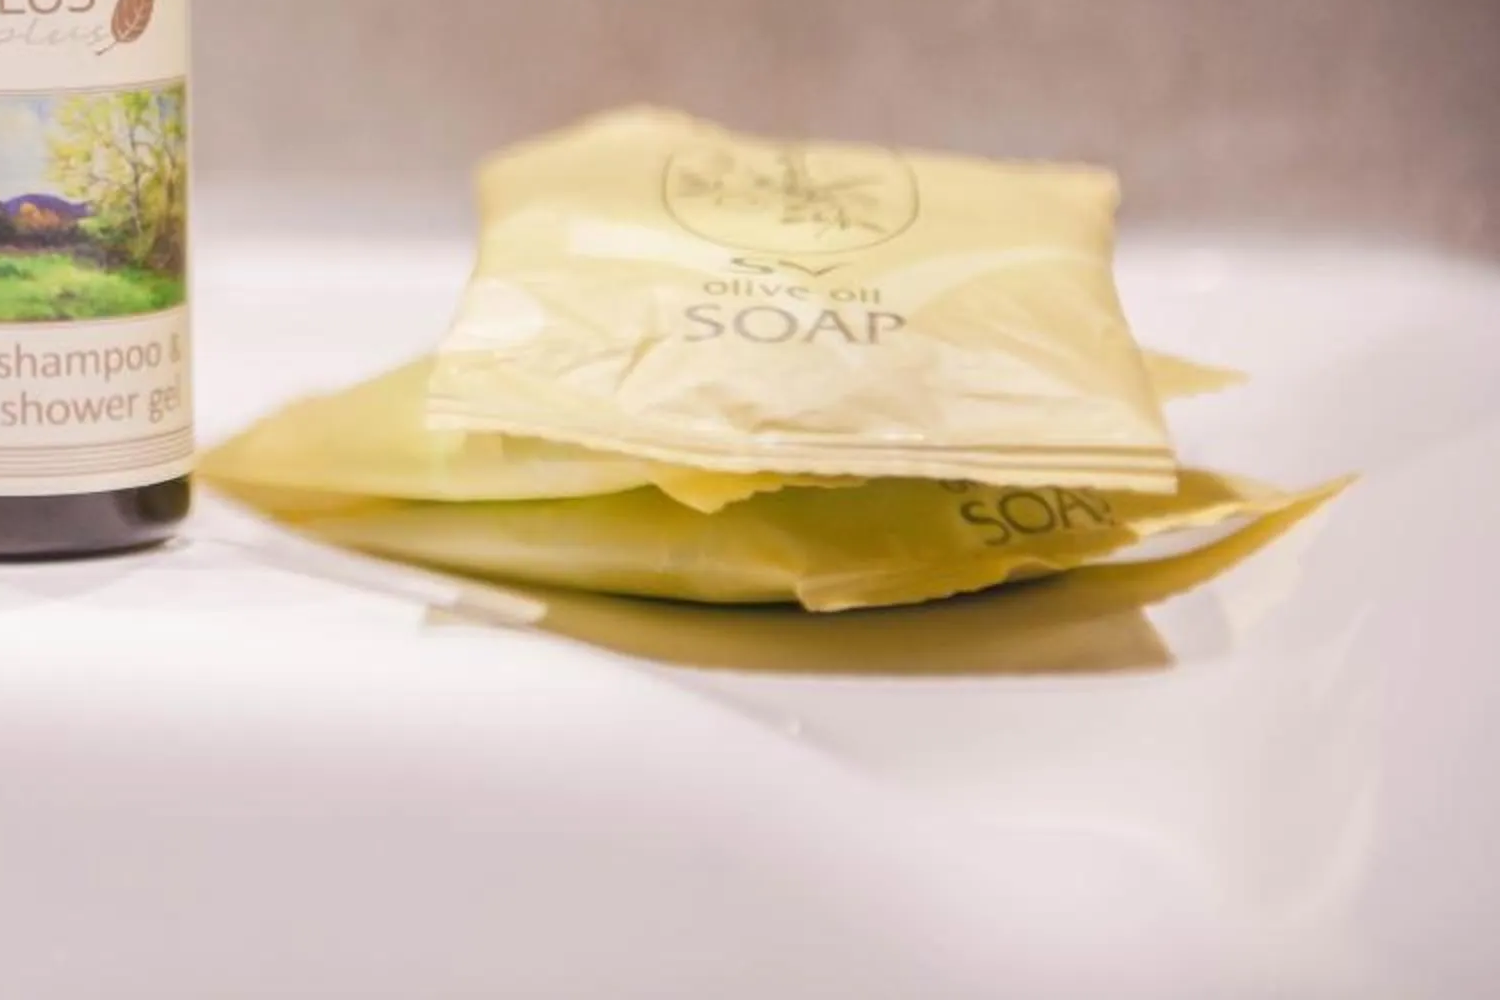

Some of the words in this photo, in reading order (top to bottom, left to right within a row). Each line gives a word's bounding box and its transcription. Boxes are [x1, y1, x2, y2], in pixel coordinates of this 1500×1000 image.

[702, 278, 811, 301] olive
[828, 286, 882, 305] oil
[682, 302, 908, 346] SOAP
[0, 391, 140, 427] shower
[148, 371, 182, 424] gel
